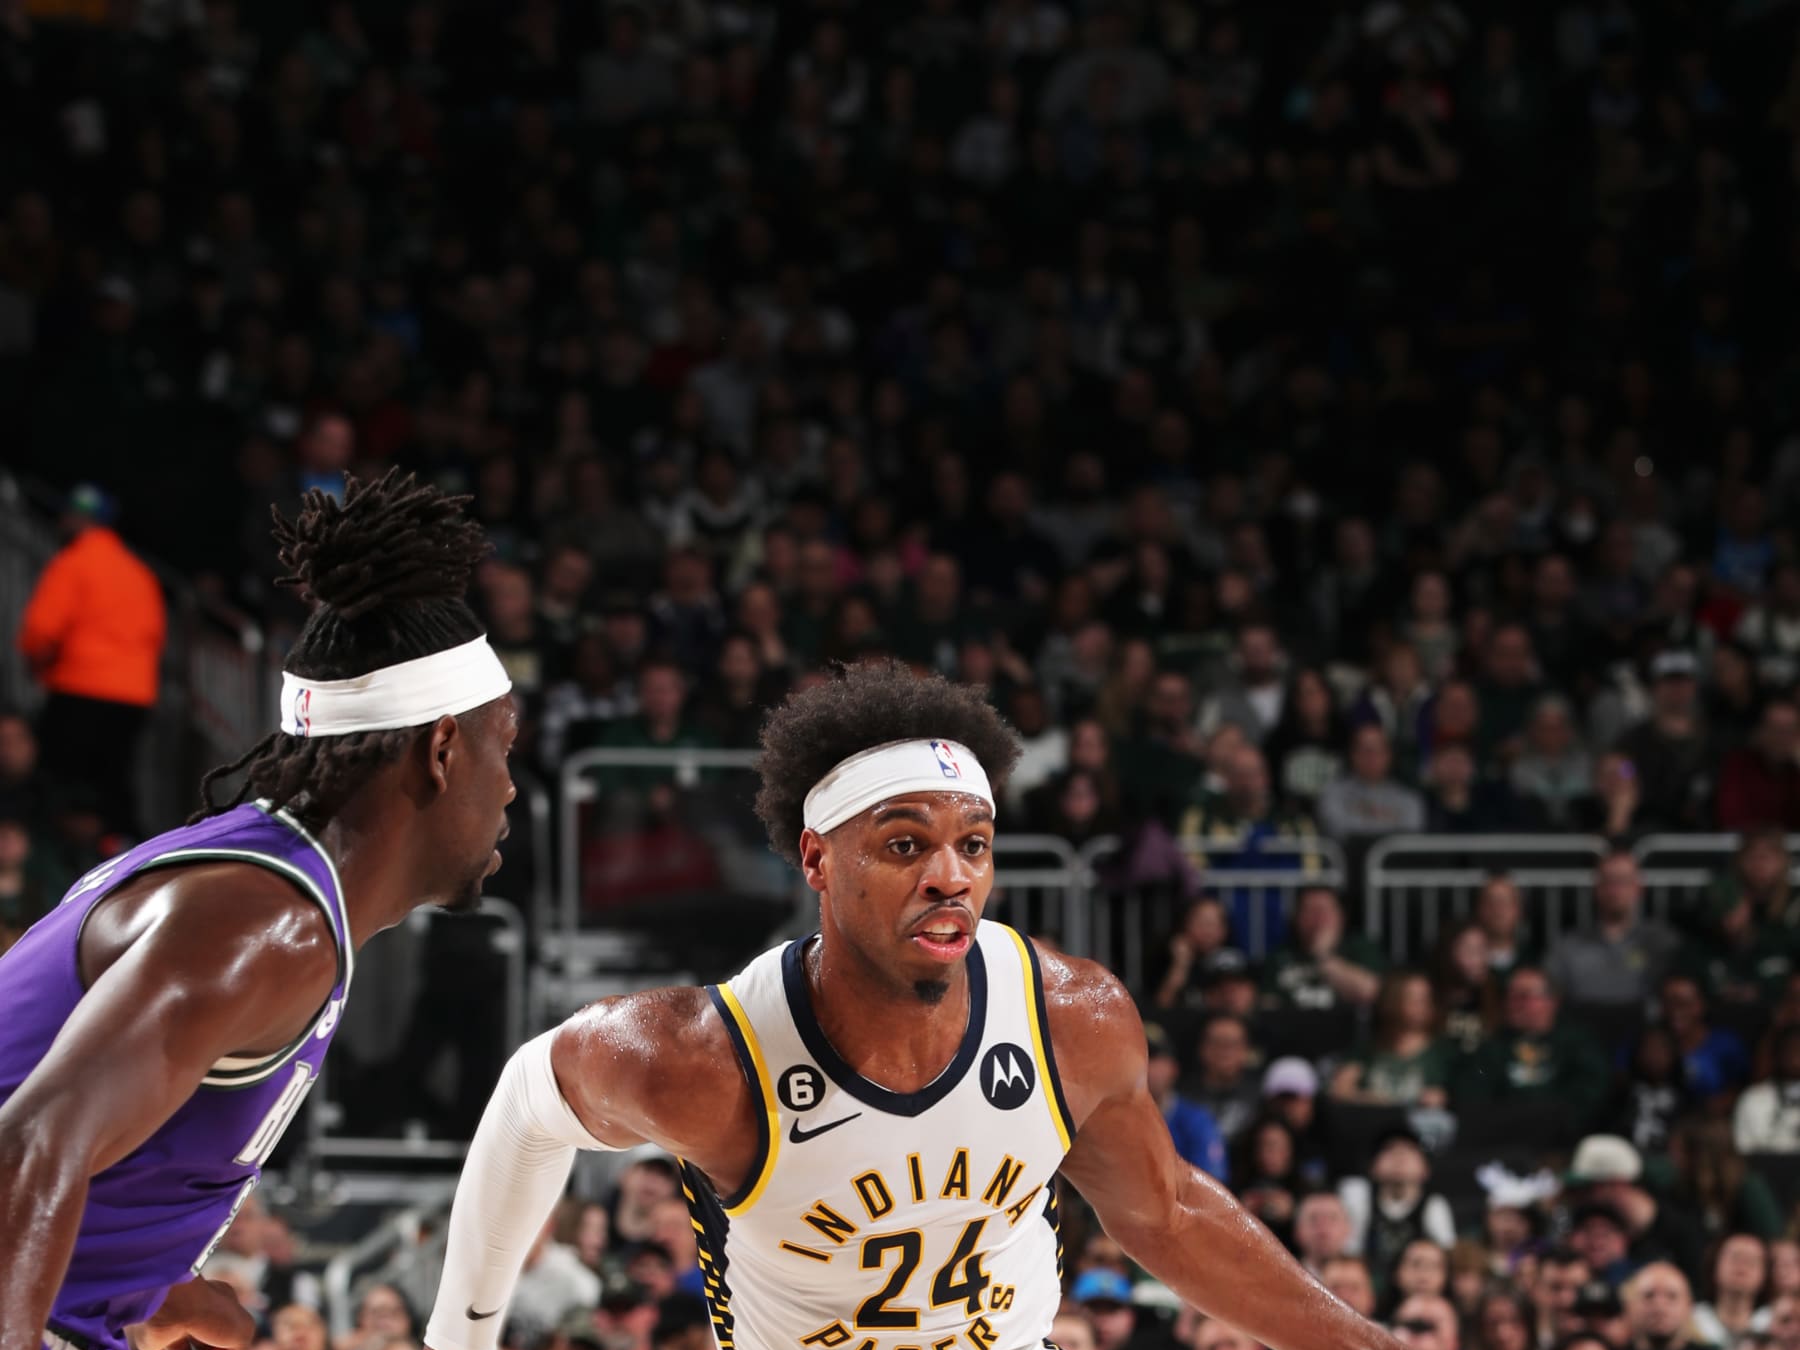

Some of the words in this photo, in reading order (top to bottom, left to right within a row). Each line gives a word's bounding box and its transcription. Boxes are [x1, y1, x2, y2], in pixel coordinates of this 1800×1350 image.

[788, 1071, 815, 1106] 6
[778, 1146, 1044, 1264] INDIANA
[853, 1216, 992, 1330] 24
